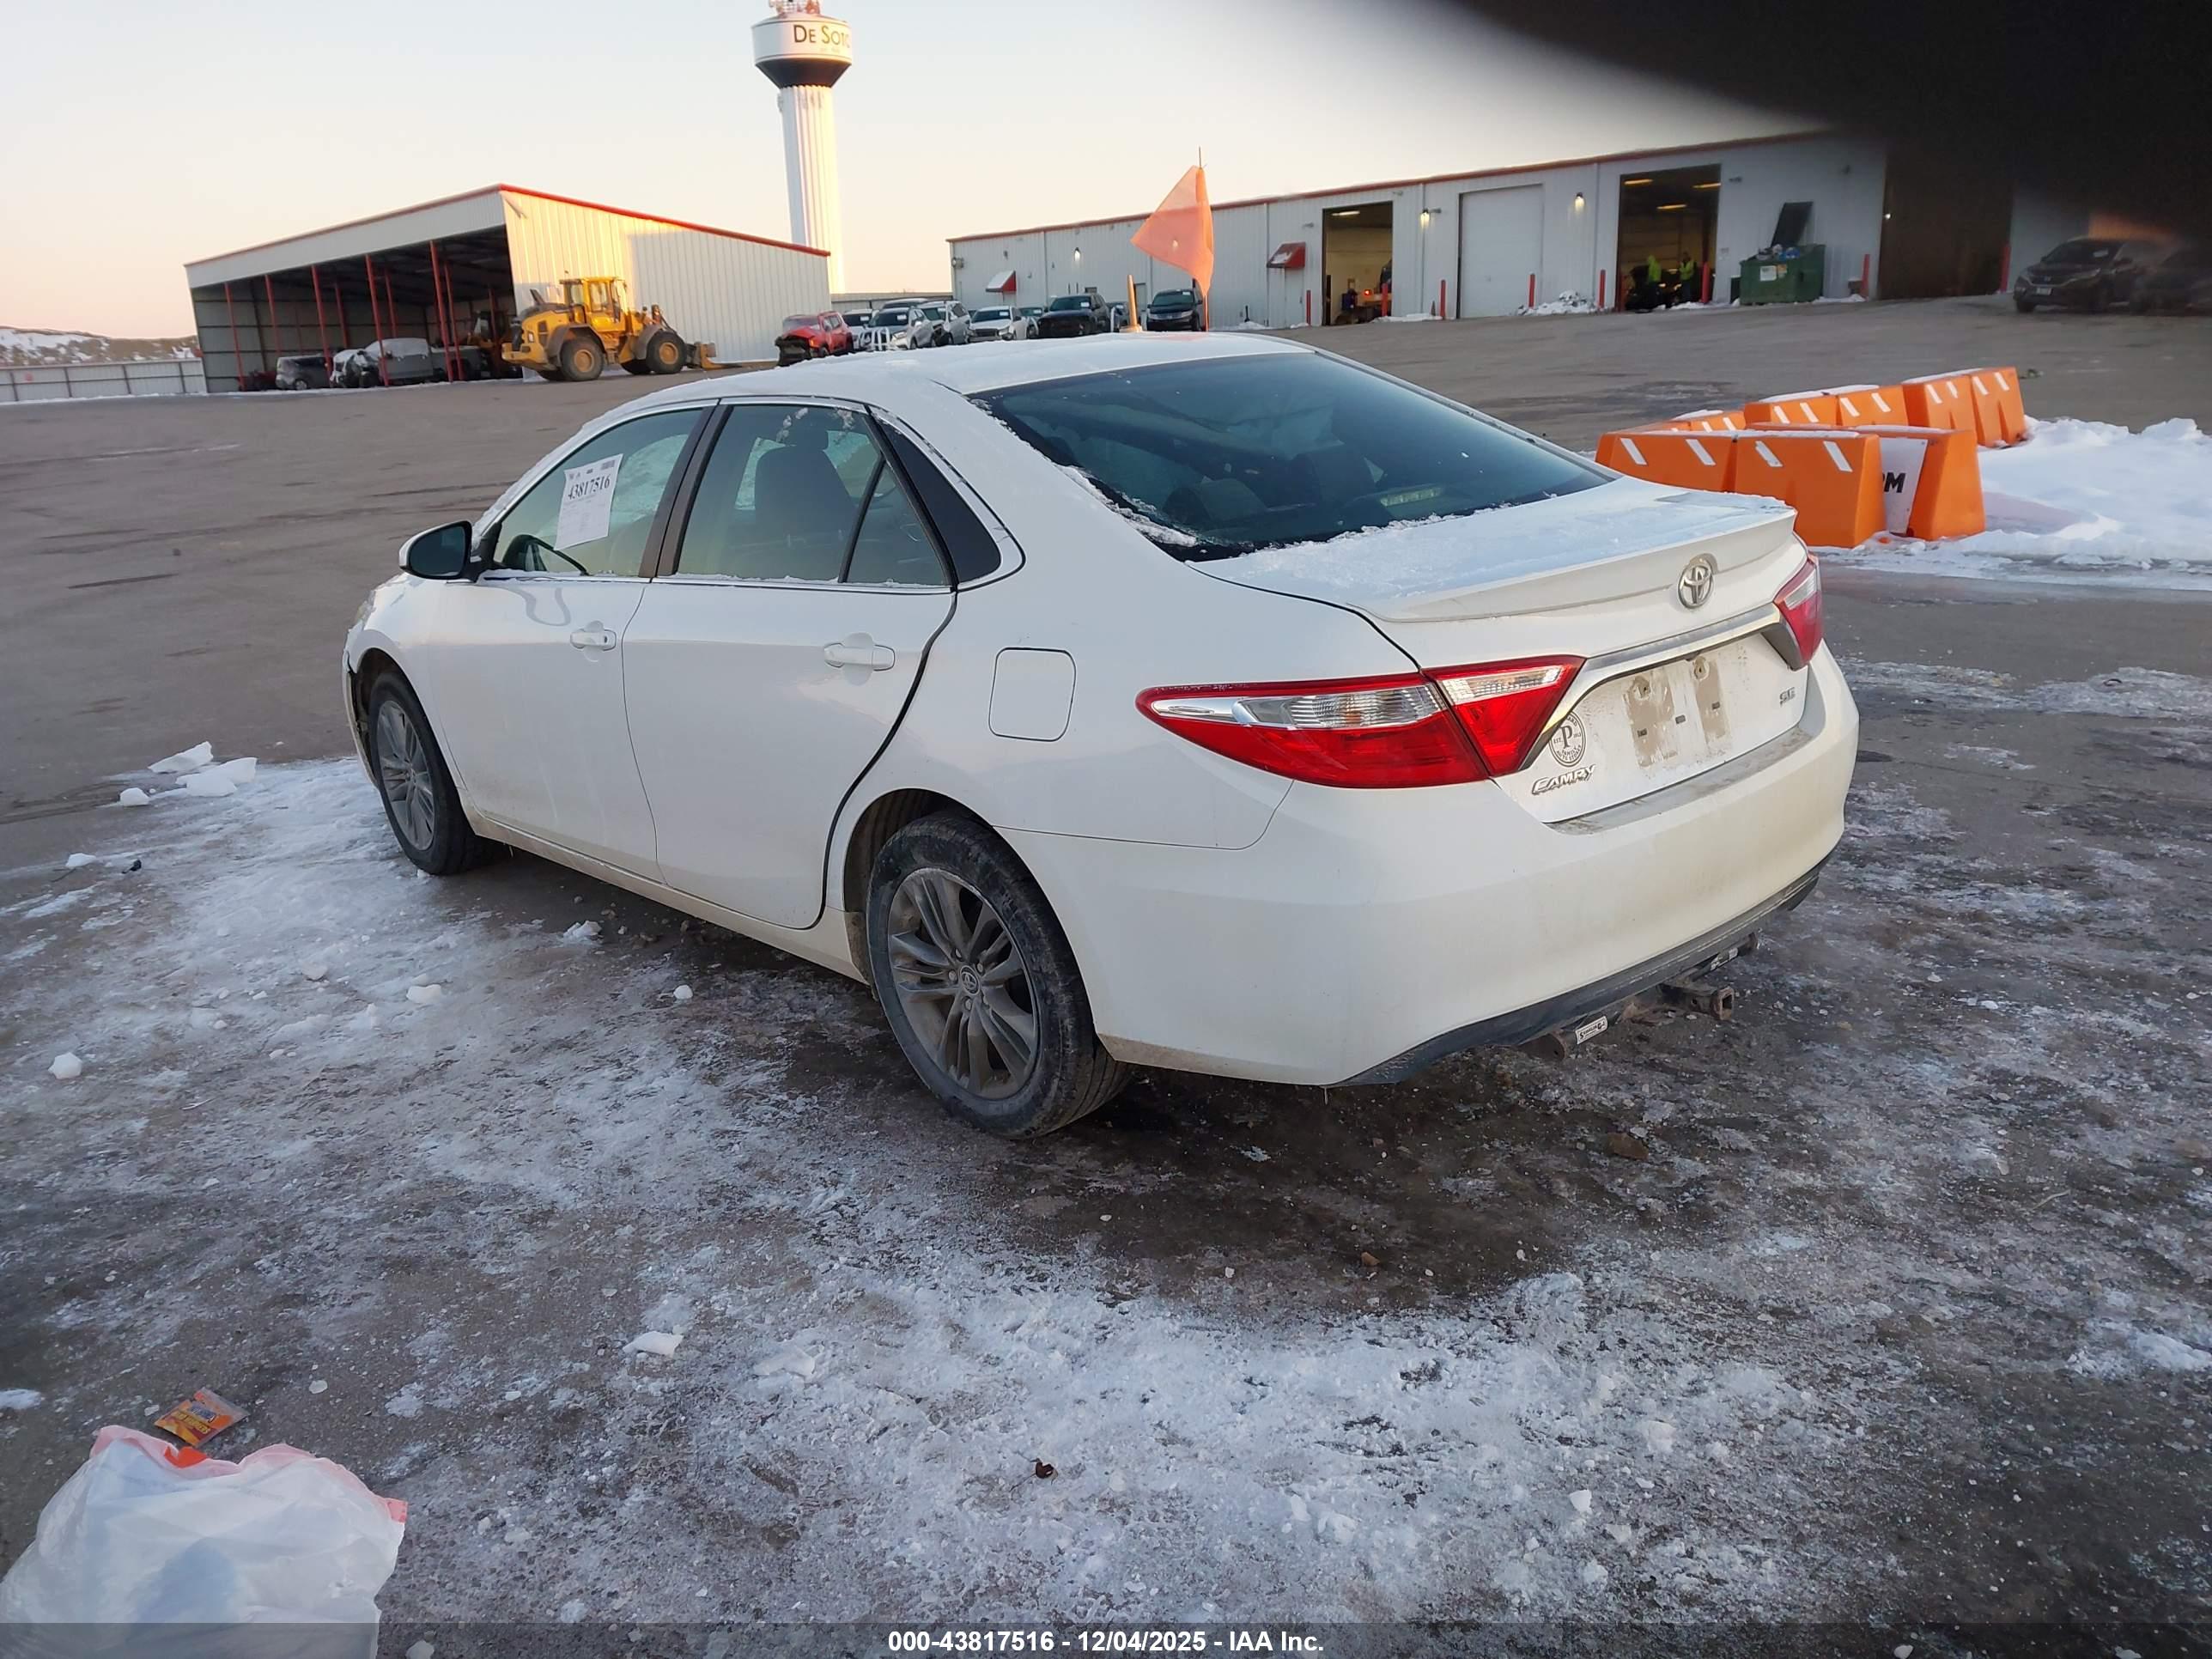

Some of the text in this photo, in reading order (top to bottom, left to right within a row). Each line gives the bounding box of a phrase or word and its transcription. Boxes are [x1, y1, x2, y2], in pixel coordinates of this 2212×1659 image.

[568, 474, 611, 500] 43817516
[1882, 472, 1906, 494] M
[1532, 764, 1595, 795] CAMRY
